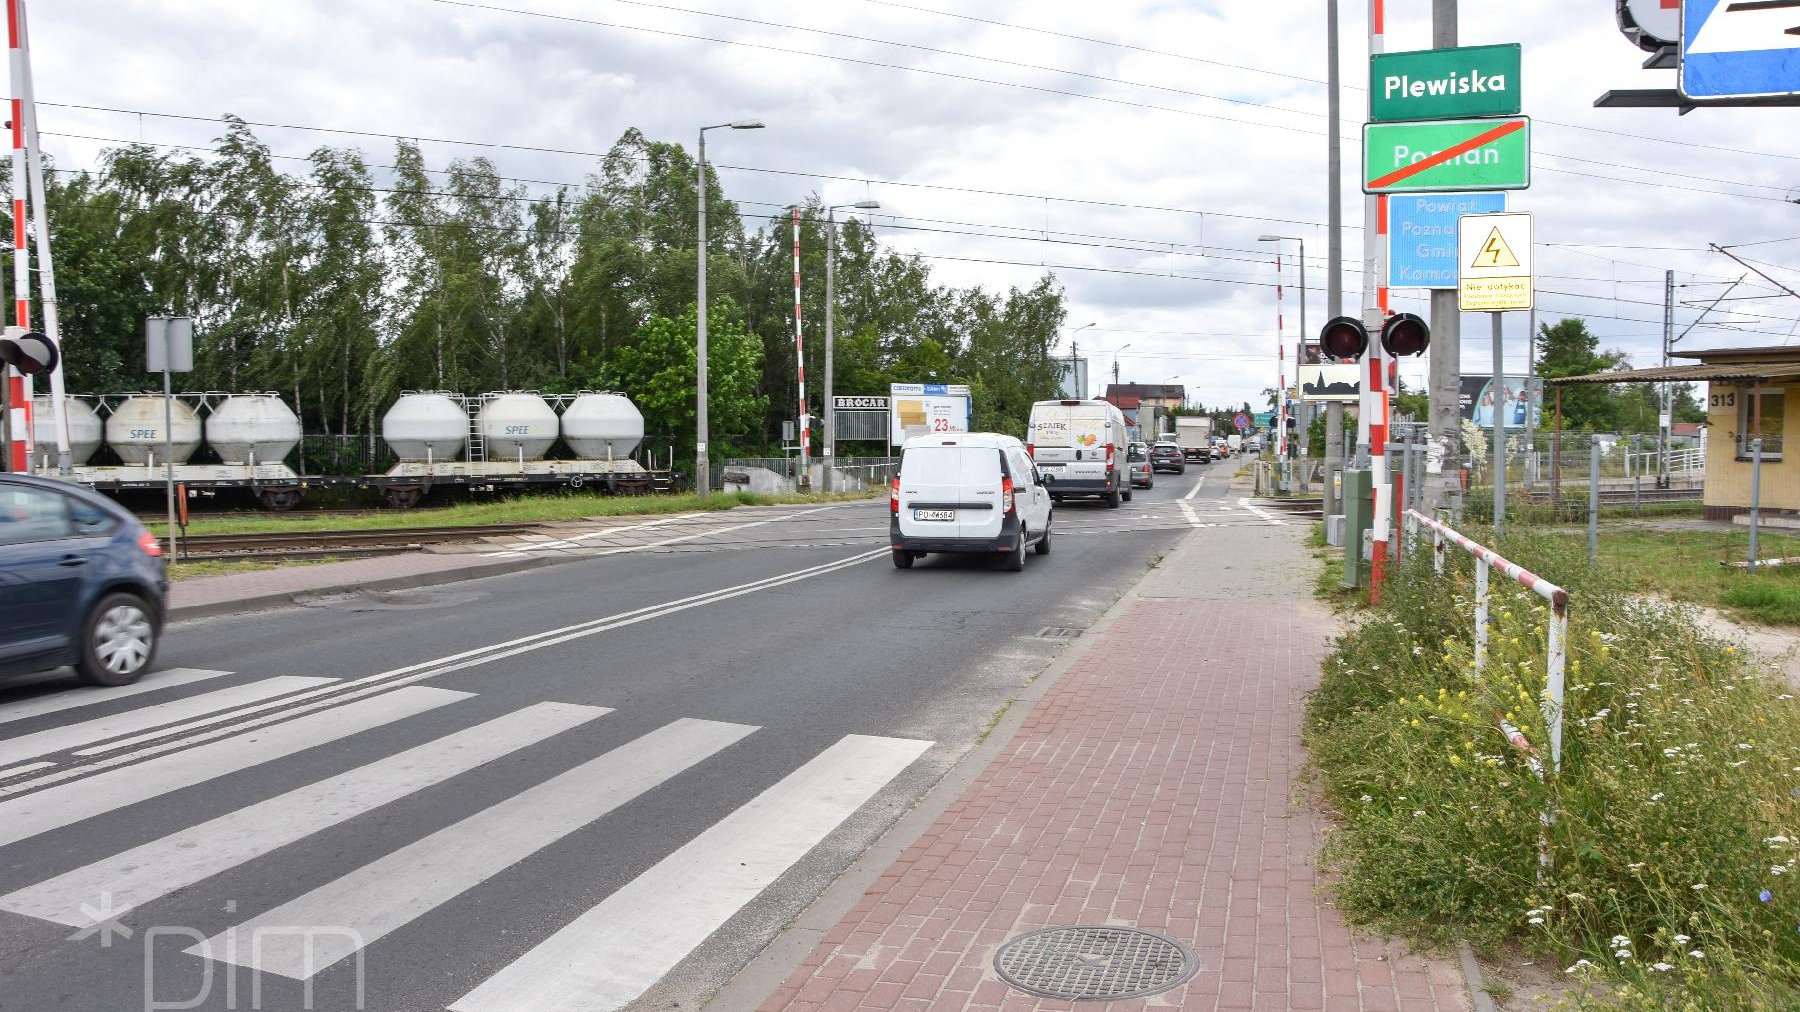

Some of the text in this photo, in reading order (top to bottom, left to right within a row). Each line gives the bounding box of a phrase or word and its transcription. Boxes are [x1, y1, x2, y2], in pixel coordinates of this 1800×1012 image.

[1384, 70, 1505, 100] Plewiska
[1393, 141, 1500, 168] Ponań
[1416, 197, 1477, 214] Powiat
[1402, 221, 1457, 237] Pozna
[1466, 283, 1482, 291] Nie
[837, 398, 886, 407] BROCAR
[1711, 393, 1735, 407] 313
[504, 425, 530, 435] SPEE
[934, 418, 948, 432] 23
[130, 429, 157, 439] SPEE
